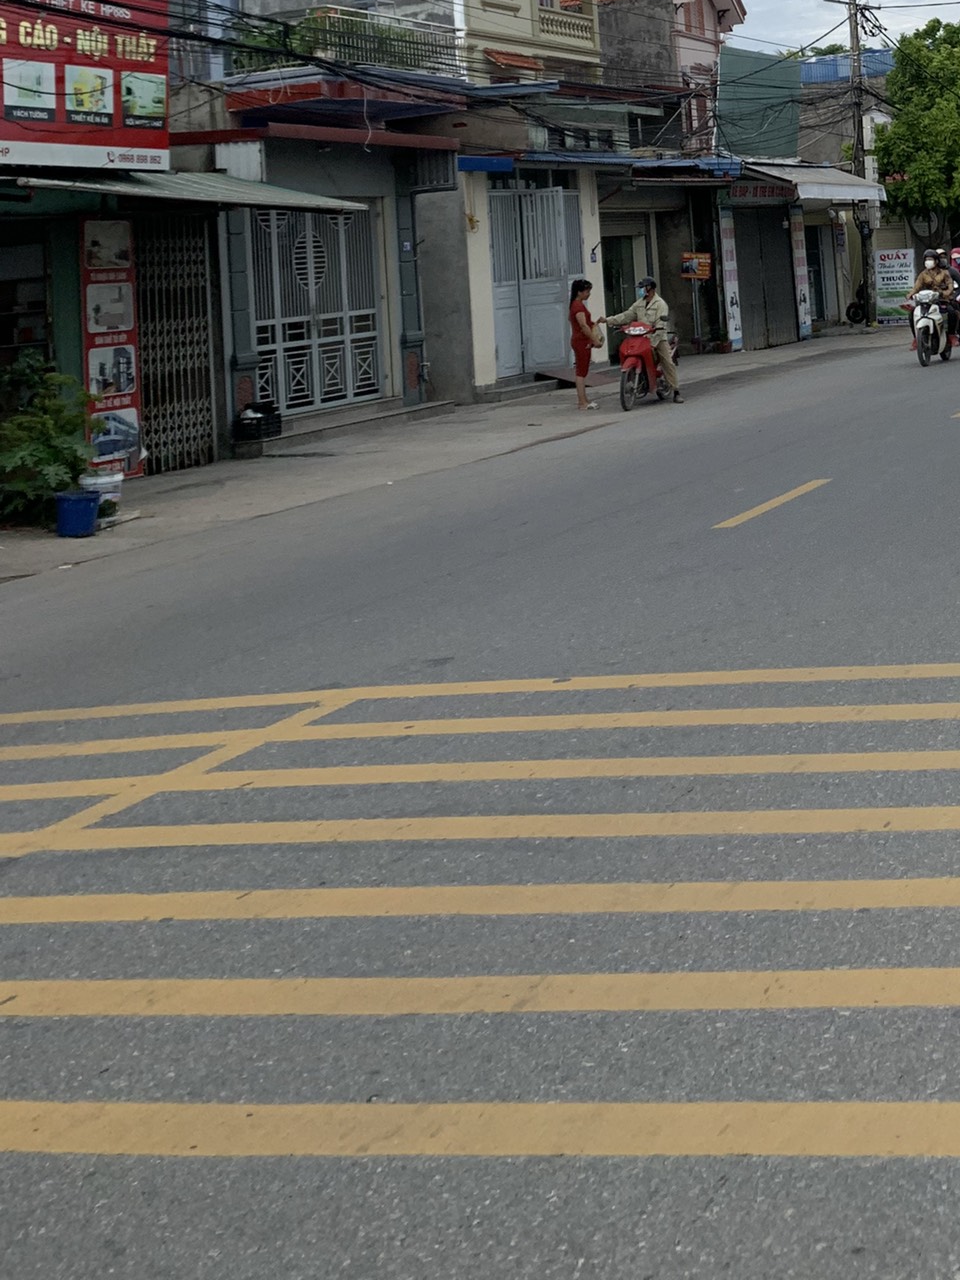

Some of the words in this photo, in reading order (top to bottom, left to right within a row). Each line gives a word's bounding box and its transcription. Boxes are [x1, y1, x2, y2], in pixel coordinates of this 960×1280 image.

[18, 19, 58, 51] CÁO
[76, 25, 110, 62] NỘI
[114, 30, 157, 63] THẤT
